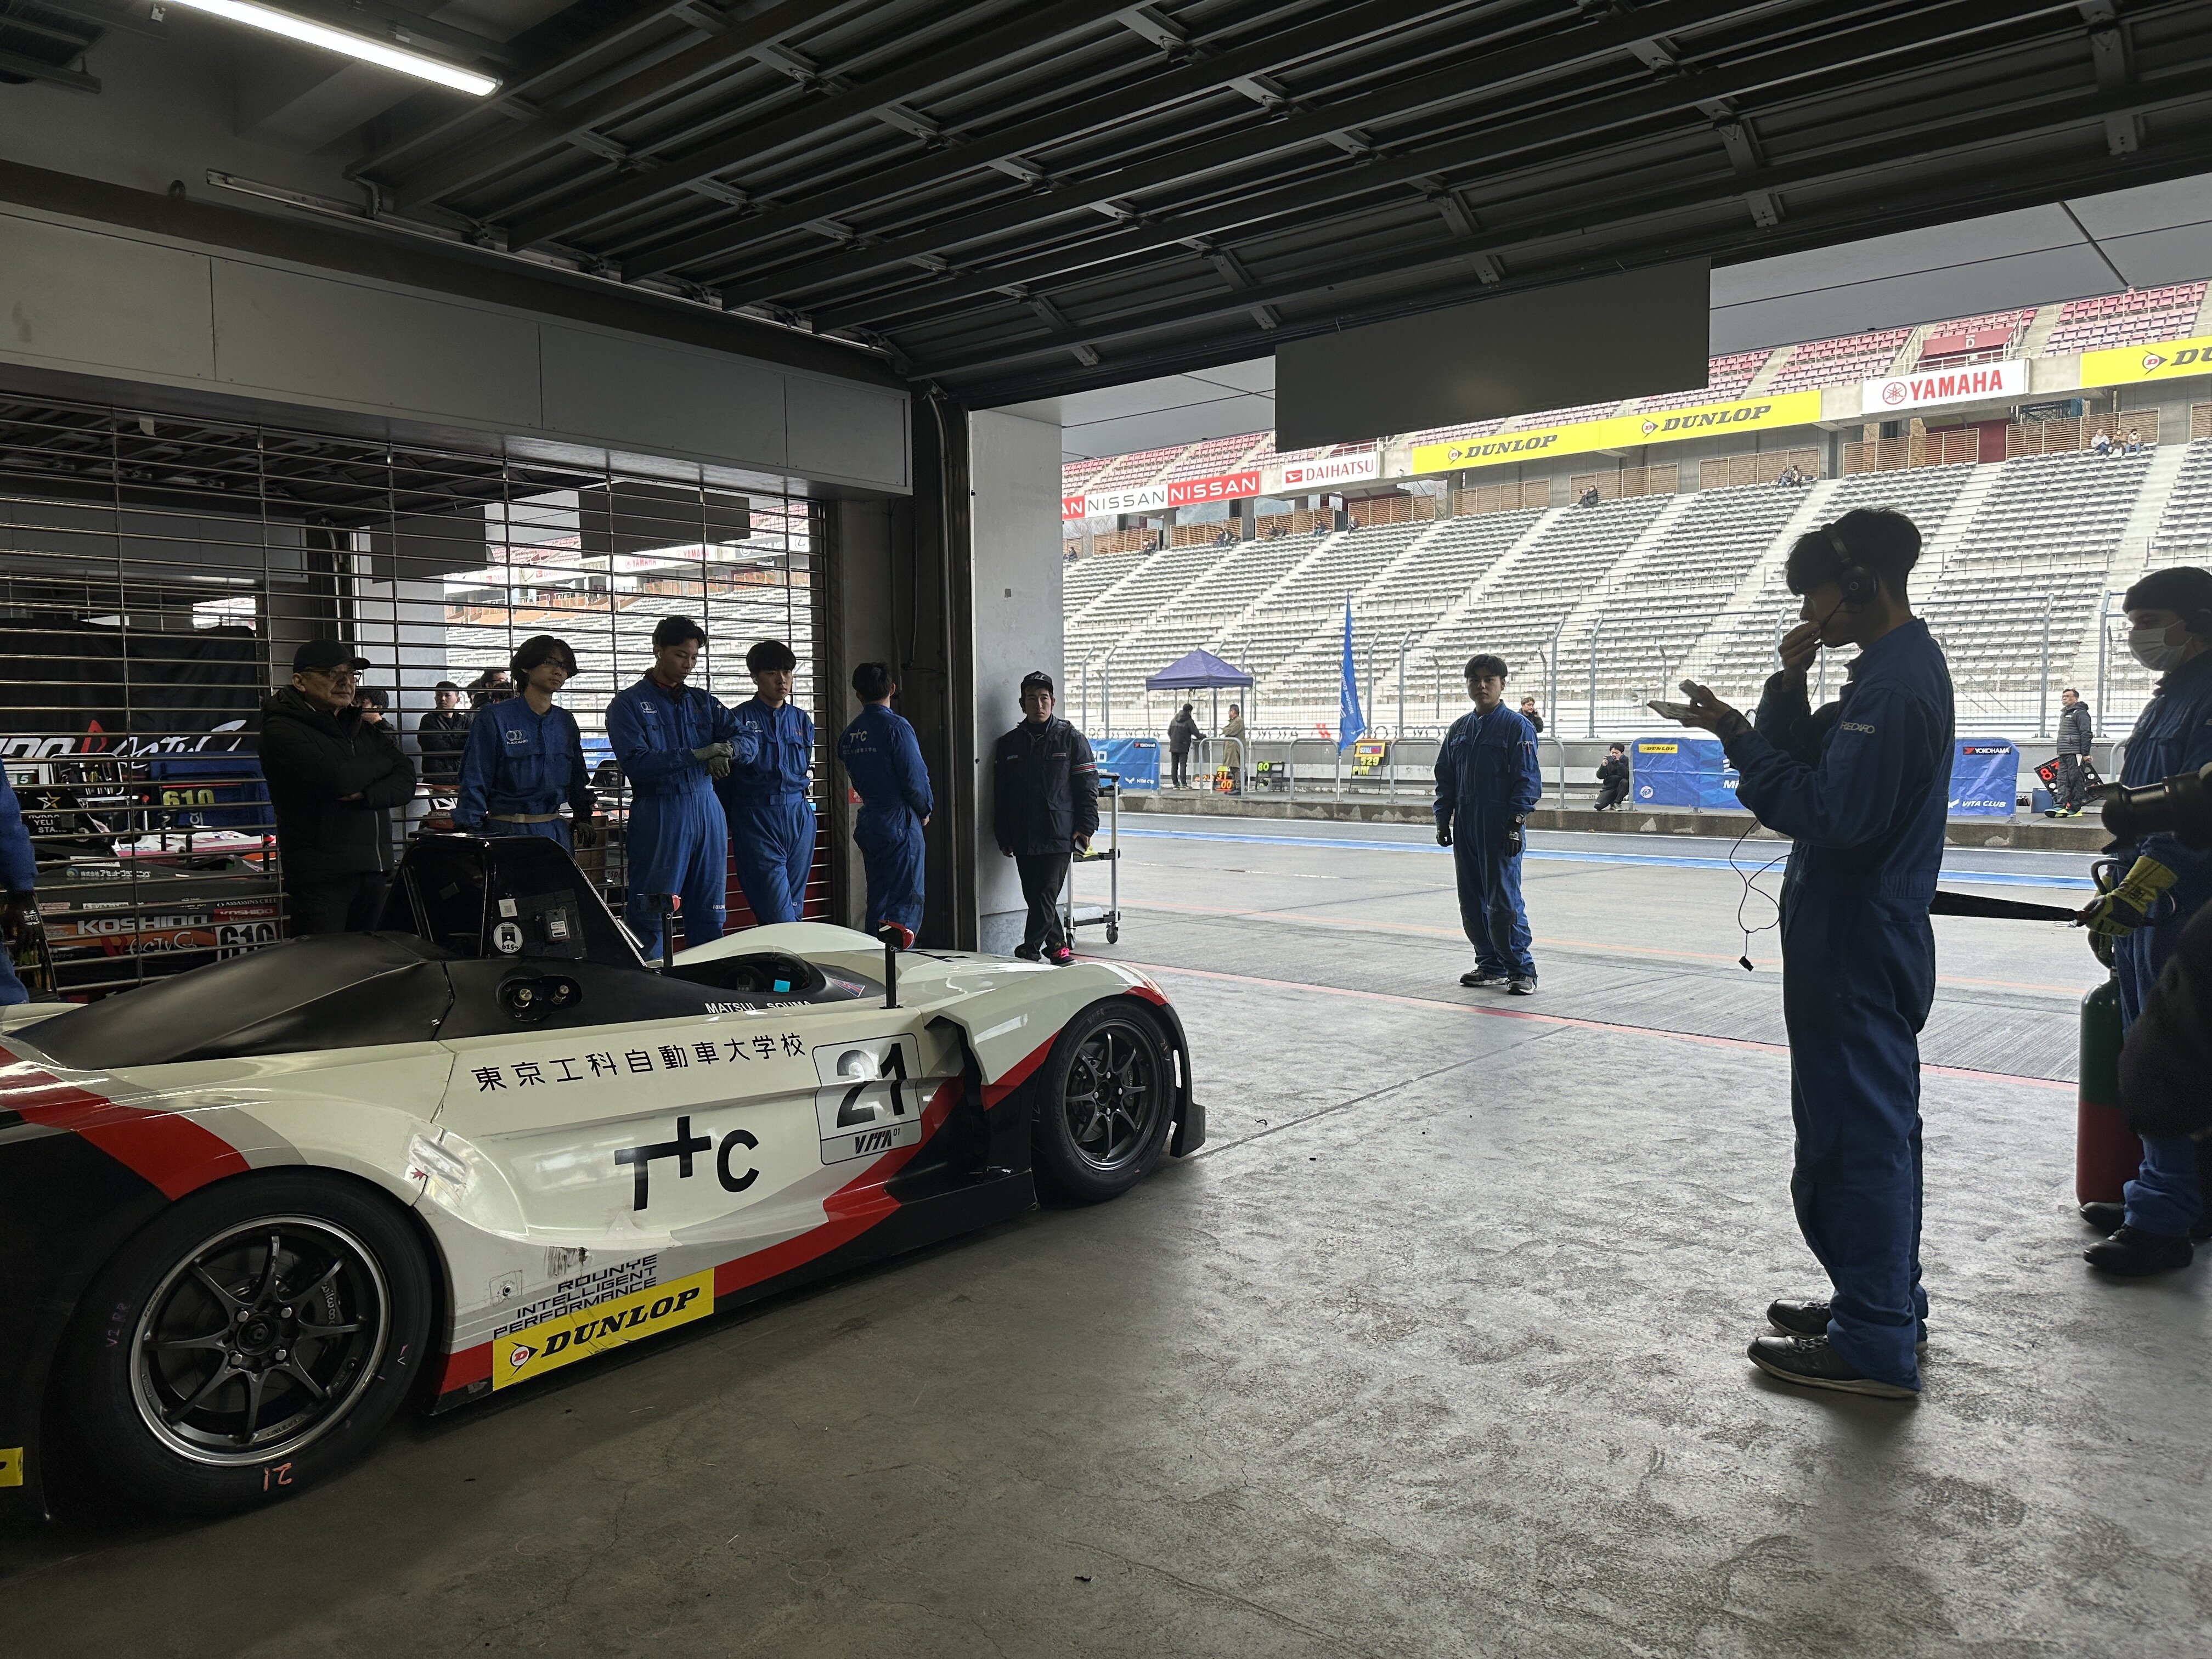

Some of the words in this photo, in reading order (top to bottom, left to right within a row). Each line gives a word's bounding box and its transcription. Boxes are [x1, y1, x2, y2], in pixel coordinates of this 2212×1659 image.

[1966, 338, 1975, 348] D
[1910, 369, 2002, 401] YAMAHA
[1661, 405, 1771, 432] DUNLOP
[1464, 435, 1558, 458] DUNLOP
[1306, 459, 1373, 481] DAIHATSU
[1171, 476, 1256, 501] NISSAN
[1088, 490, 1165, 512] NISSAN
[1257, 762, 1269, 771] 80
[1360, 757, 1380, 766] 529
[20, 775, 28, 783] 5
[162, 789, 215, 811] 610
[77, 915, 207, 934] KOSHIDO
[704, 1002, 756, 1013] MATSUI
[471, 1032, 806, 1092] 東京工科自動車大学校
[836, 1042, 907, 1128] 21
[893, 1127, 900, 1137] 01
[517, 1265, 657, 1319] INTELLIGENT
[493, 1277, 657, 1339] PERFORMANCE
[540, 1287, 700, 1358] DUNLOP
